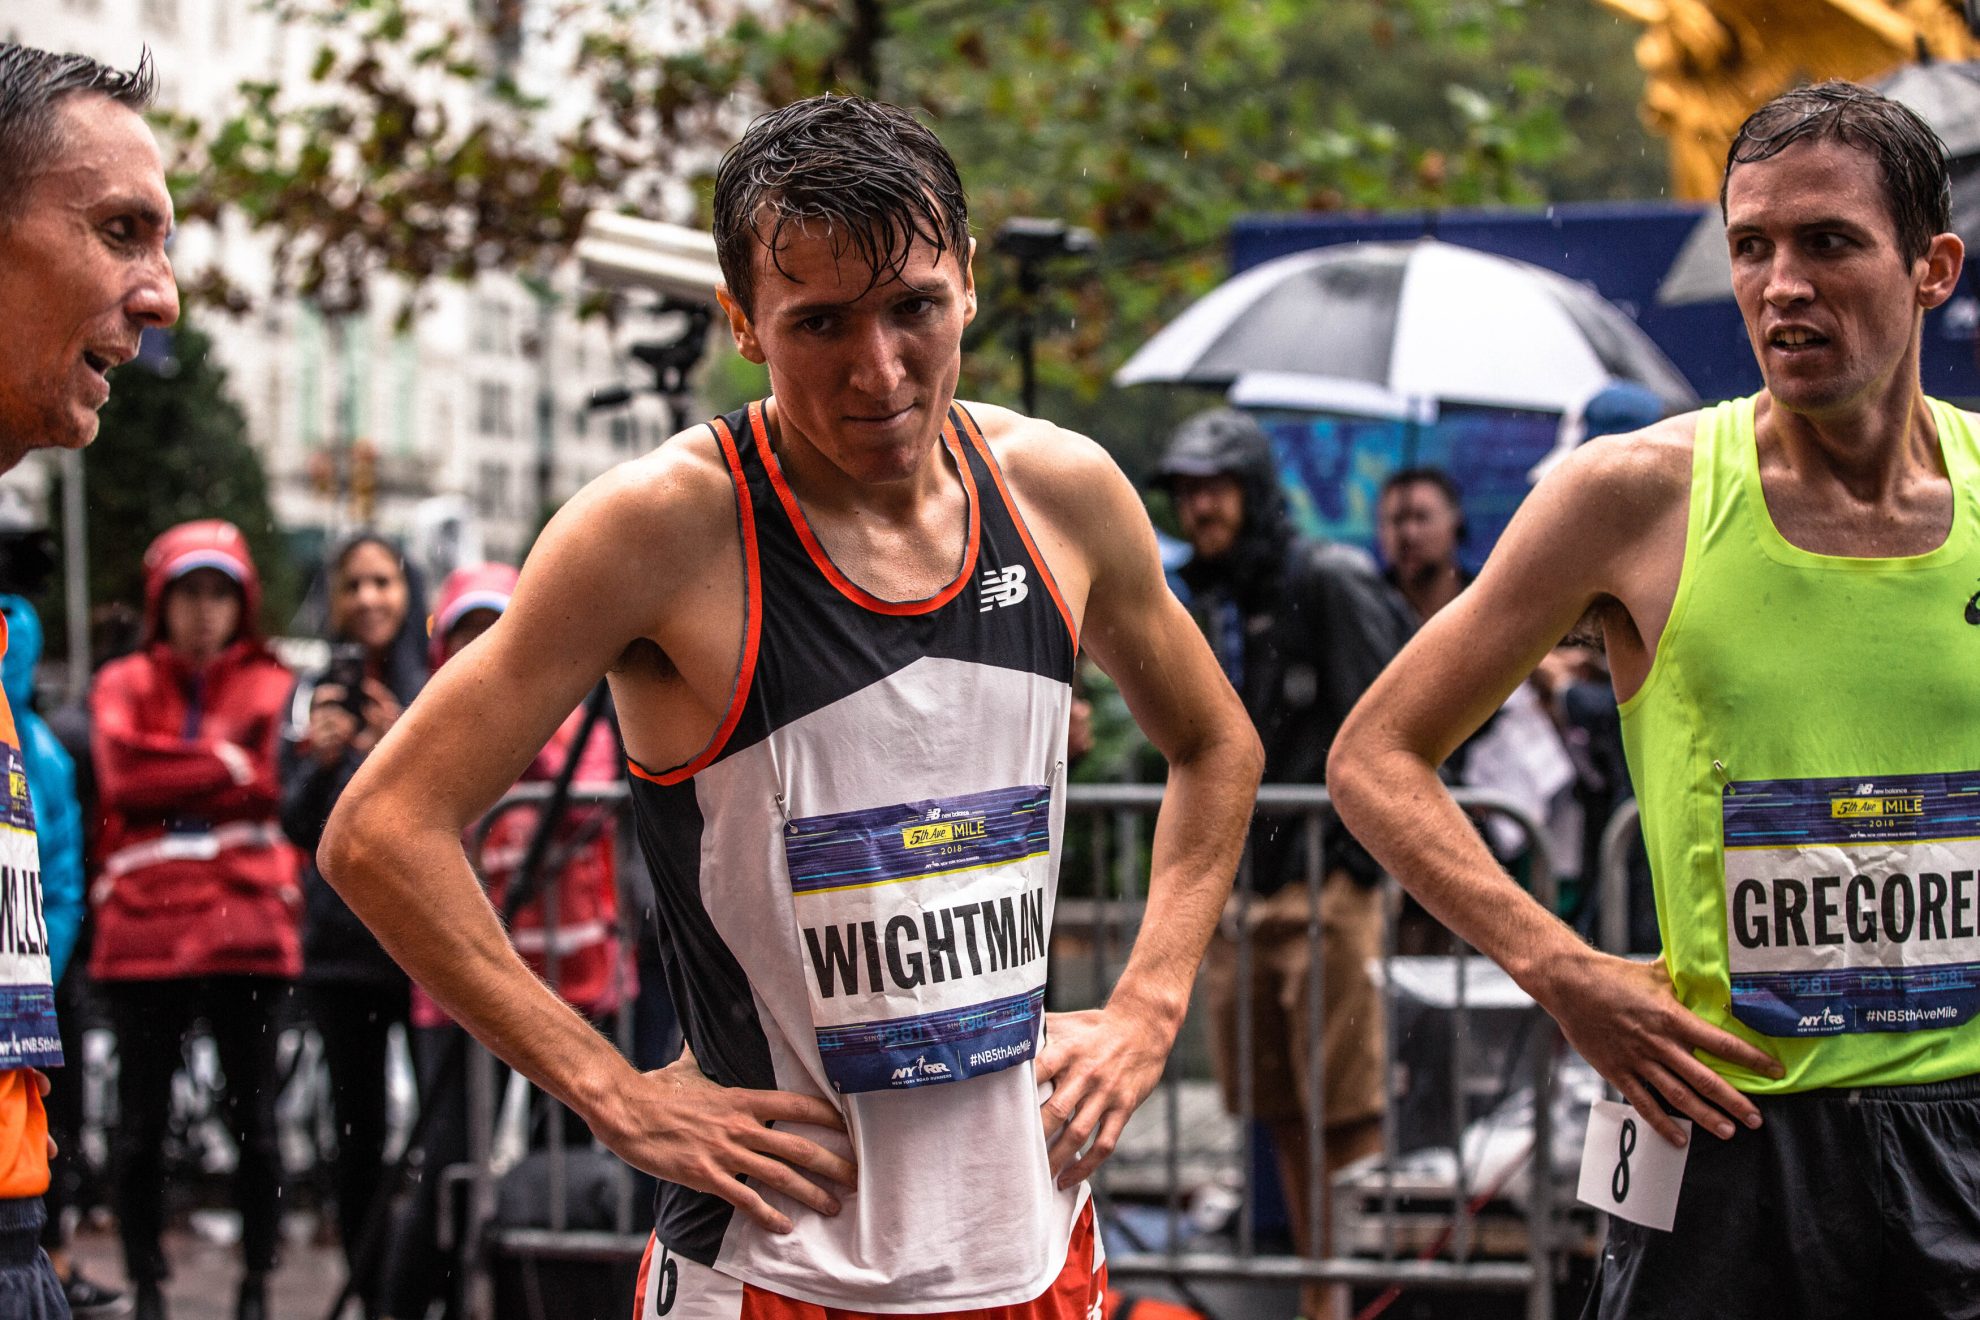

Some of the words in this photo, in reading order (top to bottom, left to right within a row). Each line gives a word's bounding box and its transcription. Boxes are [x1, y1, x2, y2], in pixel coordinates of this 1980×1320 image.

[1837, 801, 1858, 815] 5th
[1886, 799, 1922, 813] MILE
[909, 828, 928, 845] 5th
[954, 820, 985, 838] MILE
[1869, 819, 1894, 828] 2018
[940, 845, 962, 855] 2018
[1733, 869, 1980, 949] GREGORE
[803, 888, 1046, 998] WIGHTMAN
[1866, 1006, 1958, 1022] #NB5thAveMile
[970, 1039, 1032, 1067] #NB5thAveMile
[1612, 1118, 1636, 1203] 8
[657, 1245, 678, 1316] 6
